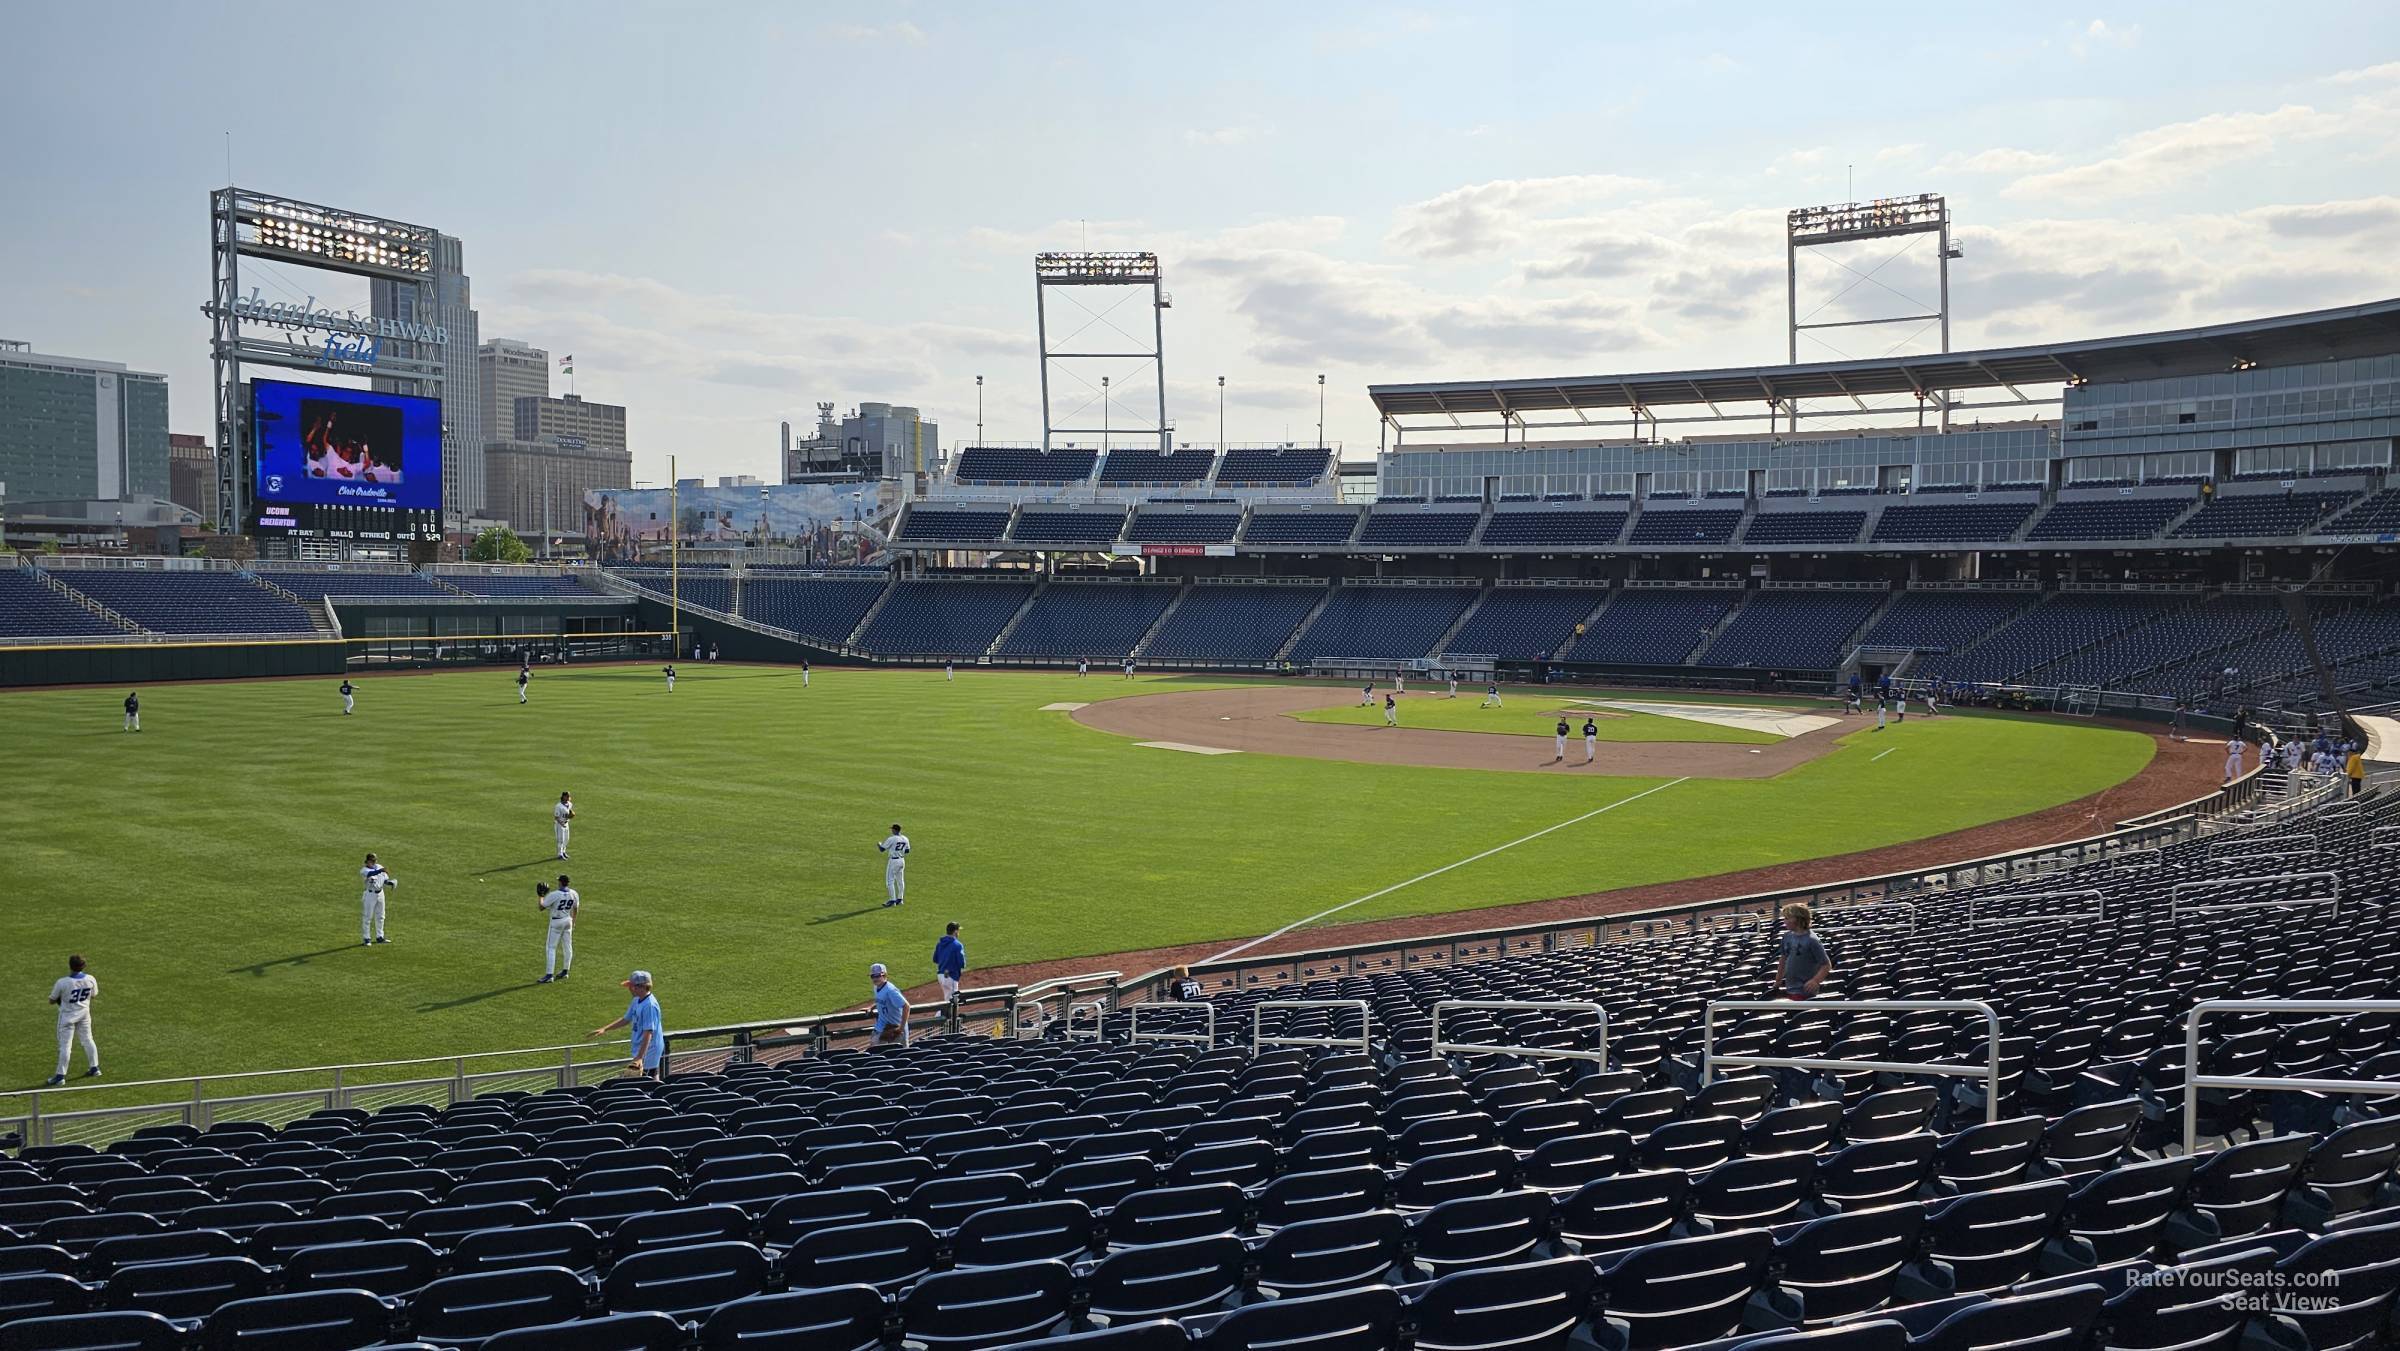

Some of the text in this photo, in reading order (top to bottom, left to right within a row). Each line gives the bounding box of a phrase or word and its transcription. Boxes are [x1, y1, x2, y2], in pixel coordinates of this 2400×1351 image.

[231, 287, 341, 328] charles
[349, 313, 448, 344] SCHWAB
[315, 333, 382, 364] field
[502, 347, 542, 359] WoodmenLife
[329, 360, 373, 374] OMAHA
[266, 507, 289, 515] UCONN
[260, 518, 296, 526] CREIGHTON
[895, 842, 906, 851] 27
[558, 900, 574, 910] 29
[69, 988, 90, 1003] 35
[1182, 985, 1200, 998] 20
